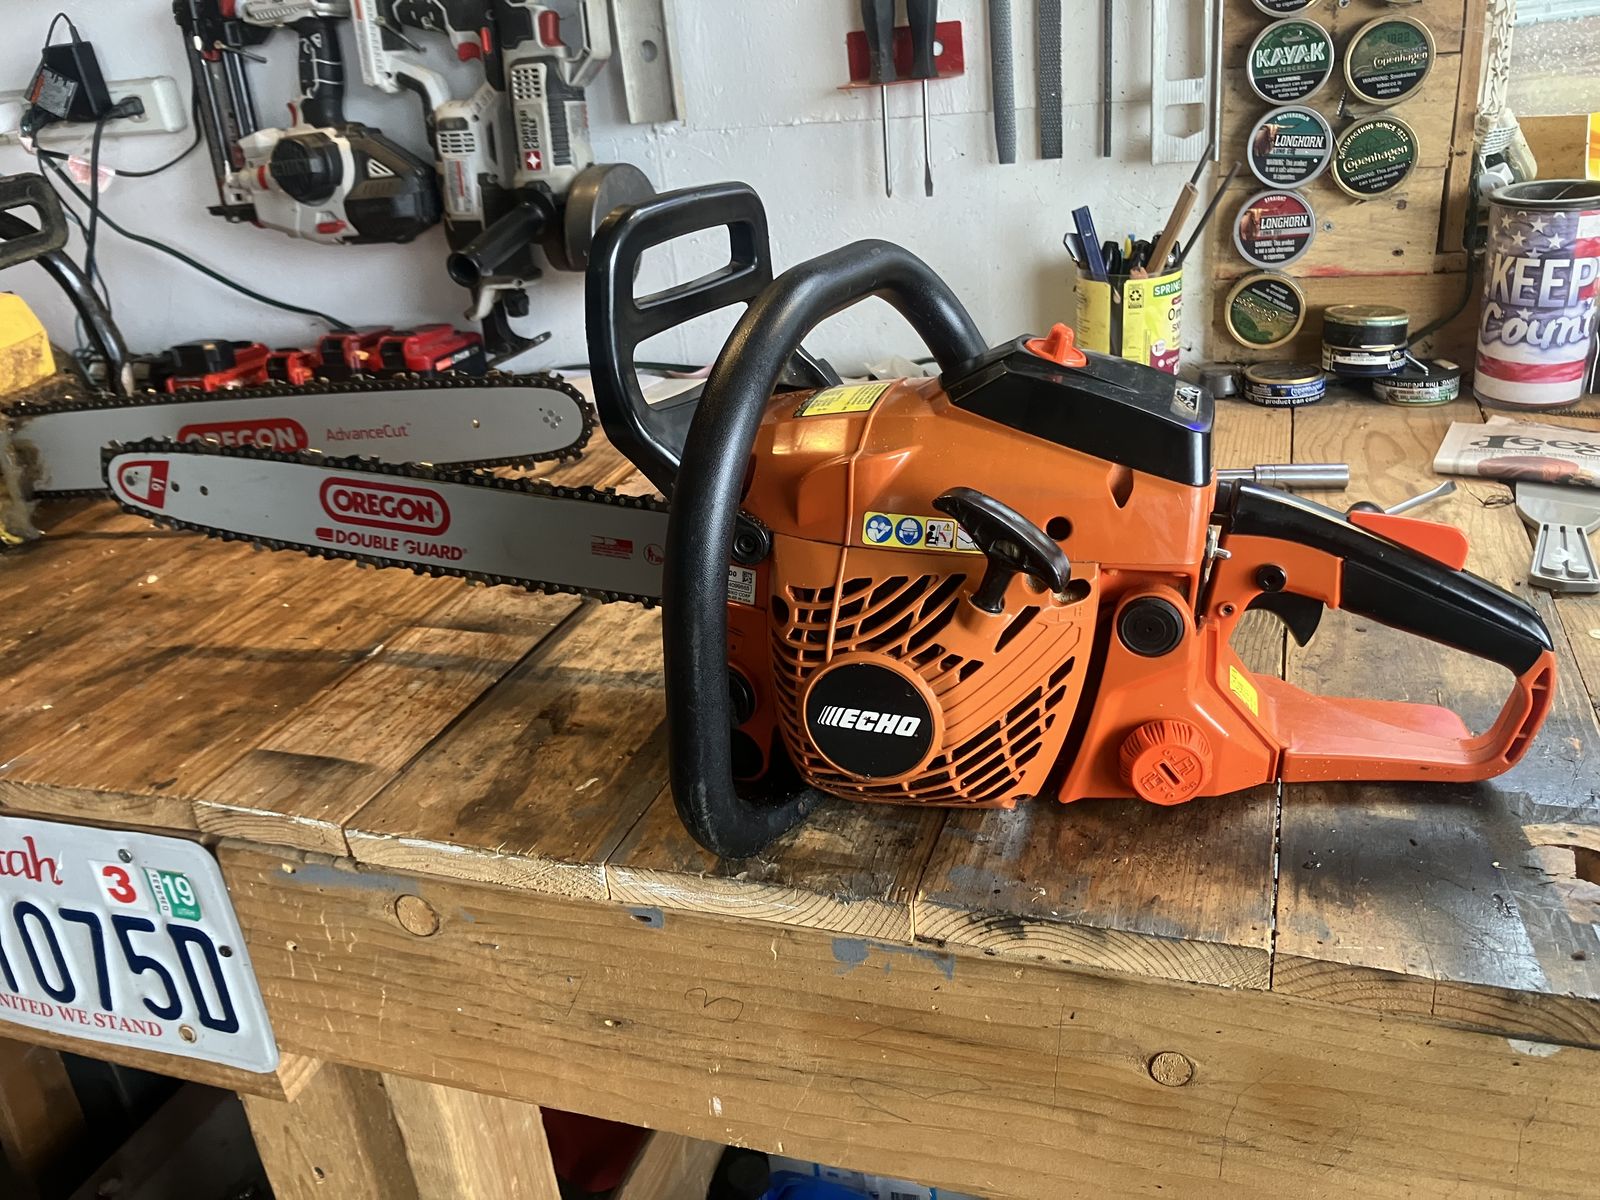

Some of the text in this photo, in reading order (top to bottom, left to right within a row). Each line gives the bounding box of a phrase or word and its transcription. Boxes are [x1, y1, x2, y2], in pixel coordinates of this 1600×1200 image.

[1256, 41, 1326, 68] KAYAK
[1373, 51, 1428, 70] Copenhagen
[1263, 64, 1316, 75] WINTERGREEN
[1274, 135, 1324, 148] LONGHORN
[1343, 145, 1408, 173] Copenhagen
[1261, 215, 1308, 230] LONGHORN
[1490, 253, 1598, 307] KEEP
[326, 424, 408, 441] AdvanceCut
[333, 489, 435, 523] OREGON
[336, 530, 464, 561] DOUBLE GUARD
[838, 708, 921, 737] ECHO
[102, 865, 137, 903] 3
[162, 874, 196, 907] 19
[56, 1004, 91, 1026] WE
[93, 1014, 163, 1038] STAND
